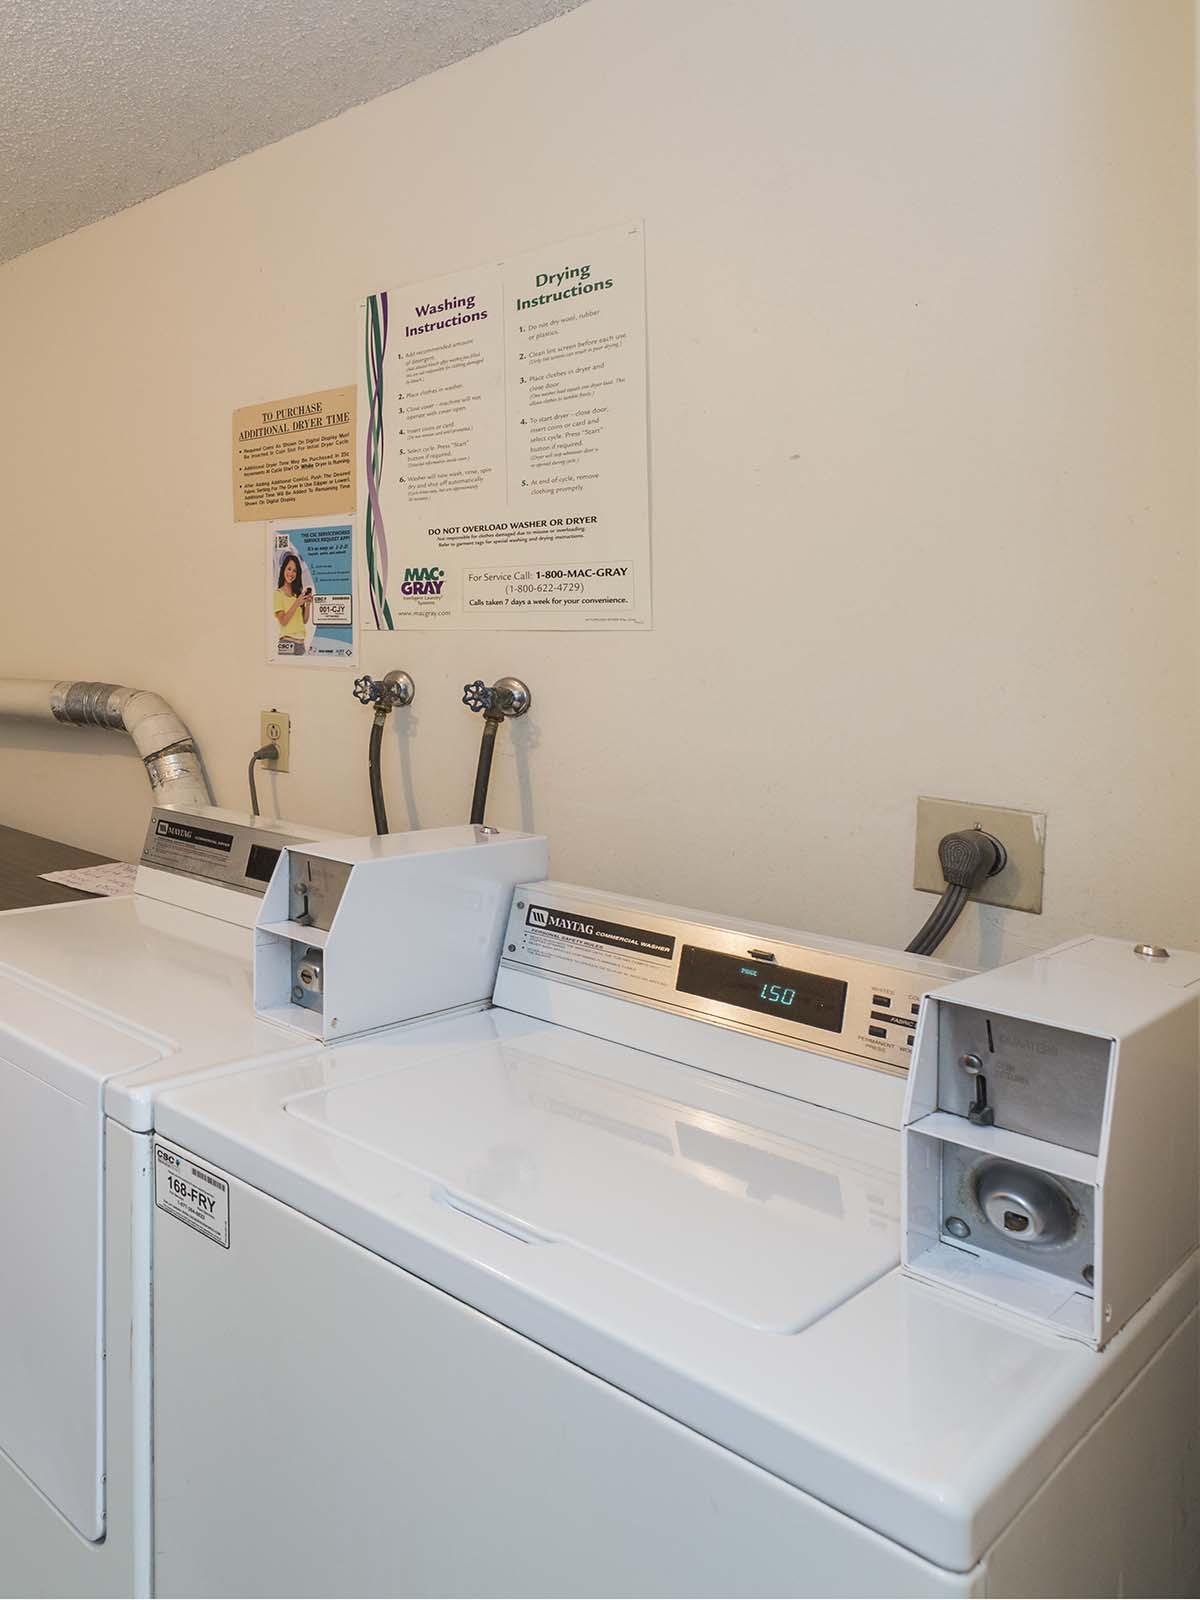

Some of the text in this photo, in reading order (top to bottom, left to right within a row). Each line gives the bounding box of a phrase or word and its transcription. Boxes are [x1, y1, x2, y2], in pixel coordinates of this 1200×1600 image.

[535, 263, 591, 289] Drying
[516, 277, 614, 311] Instructions
[415, 295, 476, 317] Washing
[405, 309, 488, 338] Instructions
[262, 402, 322, 422] TO PURCHASE
[239, 412, 350, 440] ADDITIONAL DRYER TIME
[462, 523, 508, 533] OVERLOAD
[510, 520, 547, 529] WASHER
[565, 516, 598, 525] DRYER
[468, 568, 628, 582] For Service Call: 1-800-MAC-GRAY
[401, 581, 444, 595] GRAY
[505, 582, 585, 594] (1-800-622-4729)
[510, 598, 526, 606] days
[563, 598, 579, 606] your
[581, 596, 628, 604] convenience.
[548, 916, 670, 953] MAYTAG COMMERCIAL WASHER
[157, 1150, 174, 1164] CSC
[168, 1176, 215, 1213] 168-FRY
